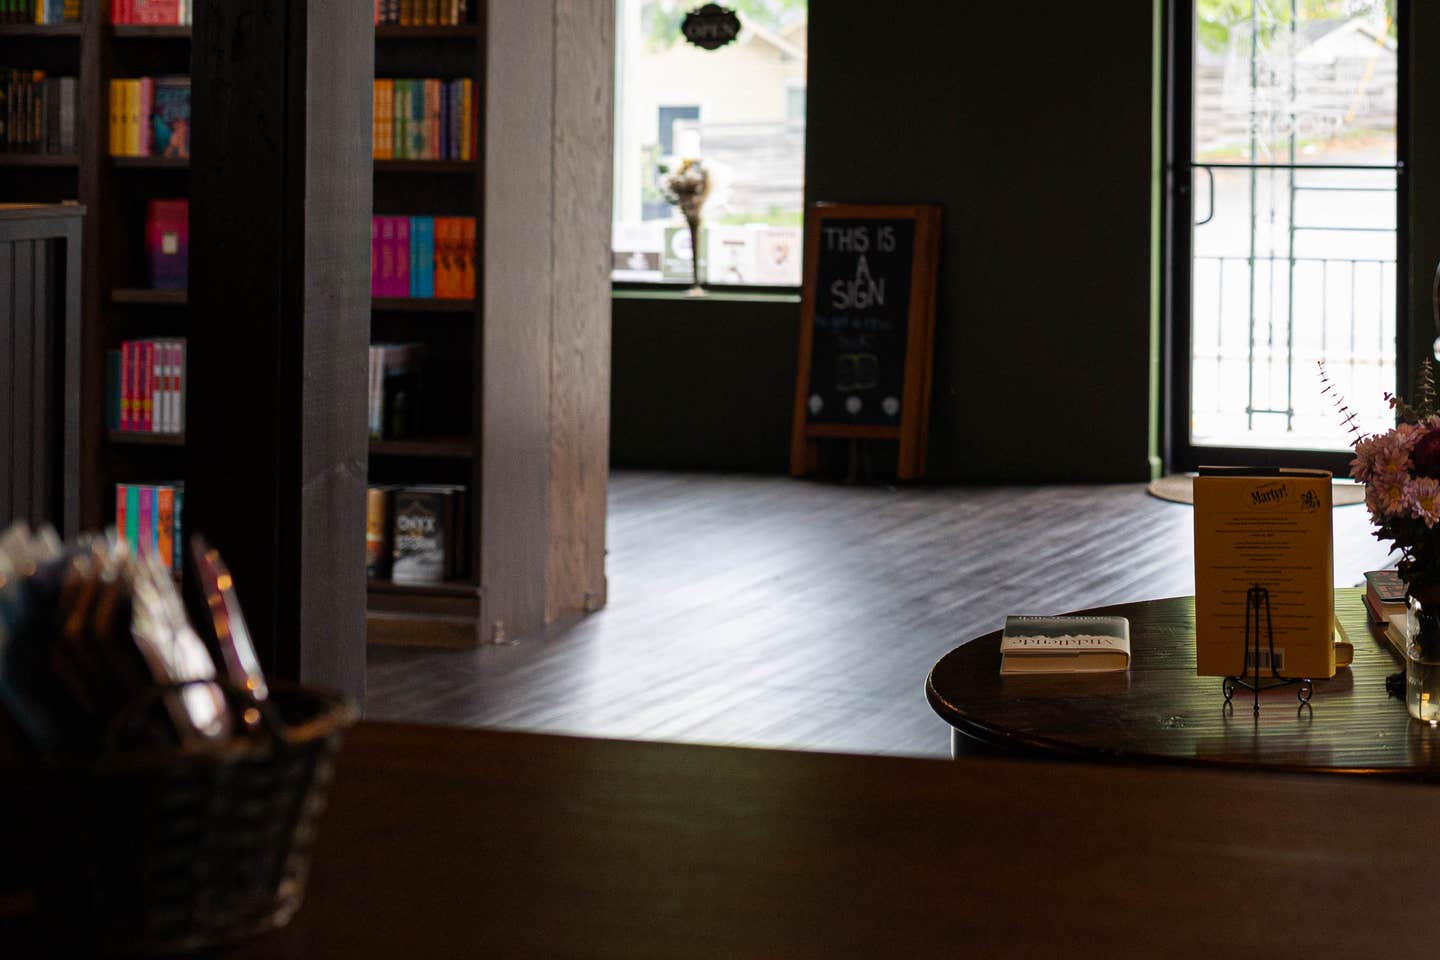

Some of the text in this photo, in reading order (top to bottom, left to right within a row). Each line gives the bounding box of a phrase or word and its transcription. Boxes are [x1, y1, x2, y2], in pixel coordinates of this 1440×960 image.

[823, 225, 896, 253] THIS IS
[856, 254, 870, 279] A
[830, 278, 885, 310] SIGN
[1250, 484, 1288, 506] Martyr!
